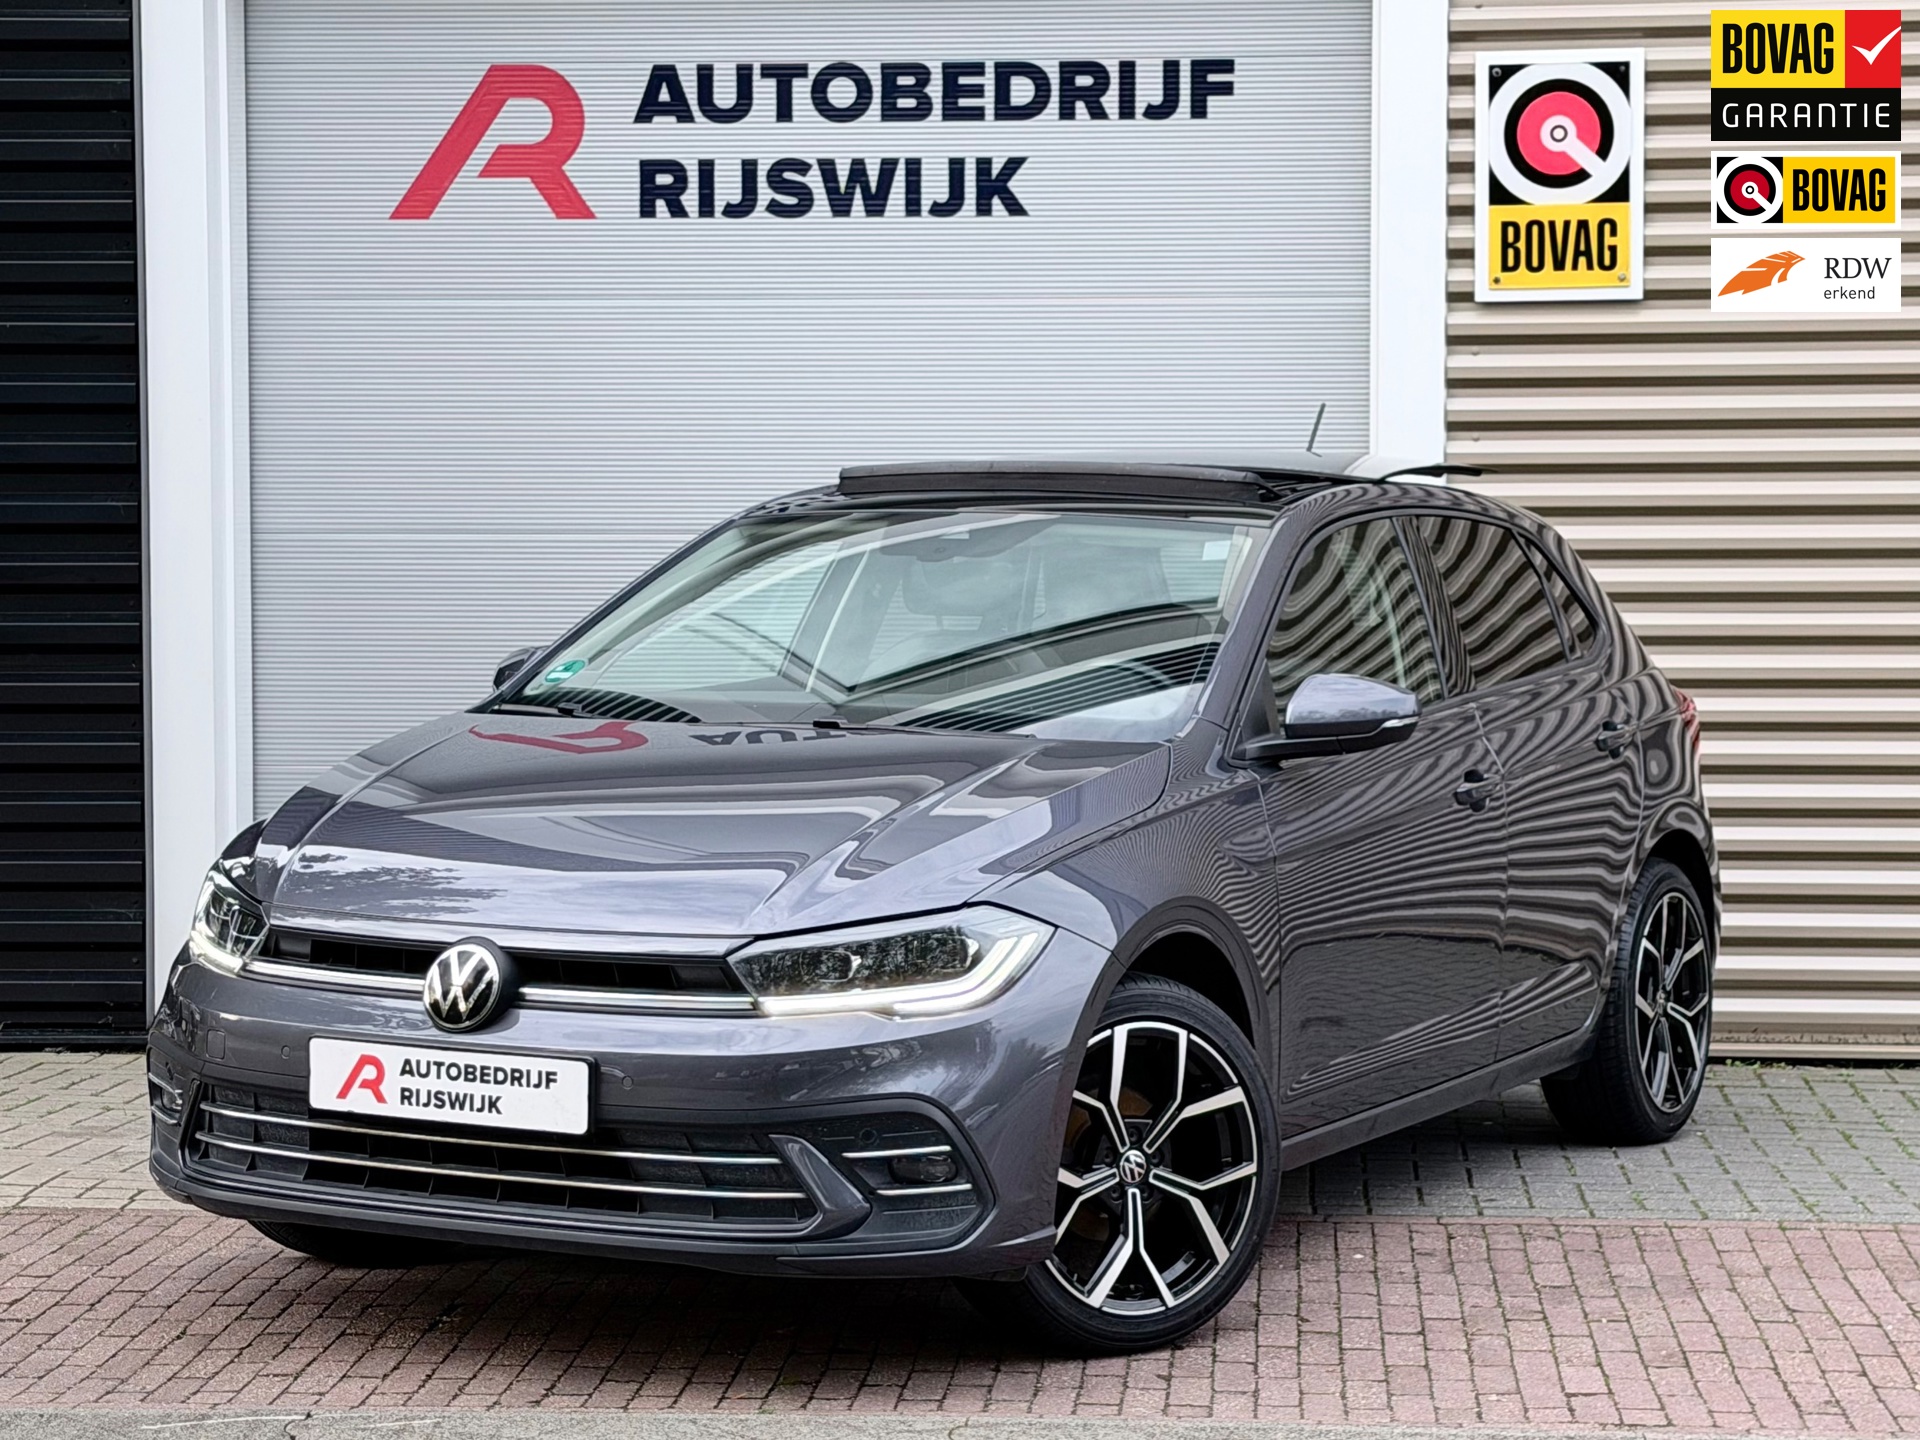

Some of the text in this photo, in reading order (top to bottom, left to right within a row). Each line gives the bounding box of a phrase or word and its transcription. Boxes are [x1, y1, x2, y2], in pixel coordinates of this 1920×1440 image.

[634, 59, 1236, 124] AUTOBEDRIJF
[639, 156, 1030, 219] RIJSWIJK
[1501, 217, 1618, 273] BOVAG
[399, 1058, 558, 1090] AUTOBEDRIJF
[400, 1087, 503, 1115] RIJSWIJK
